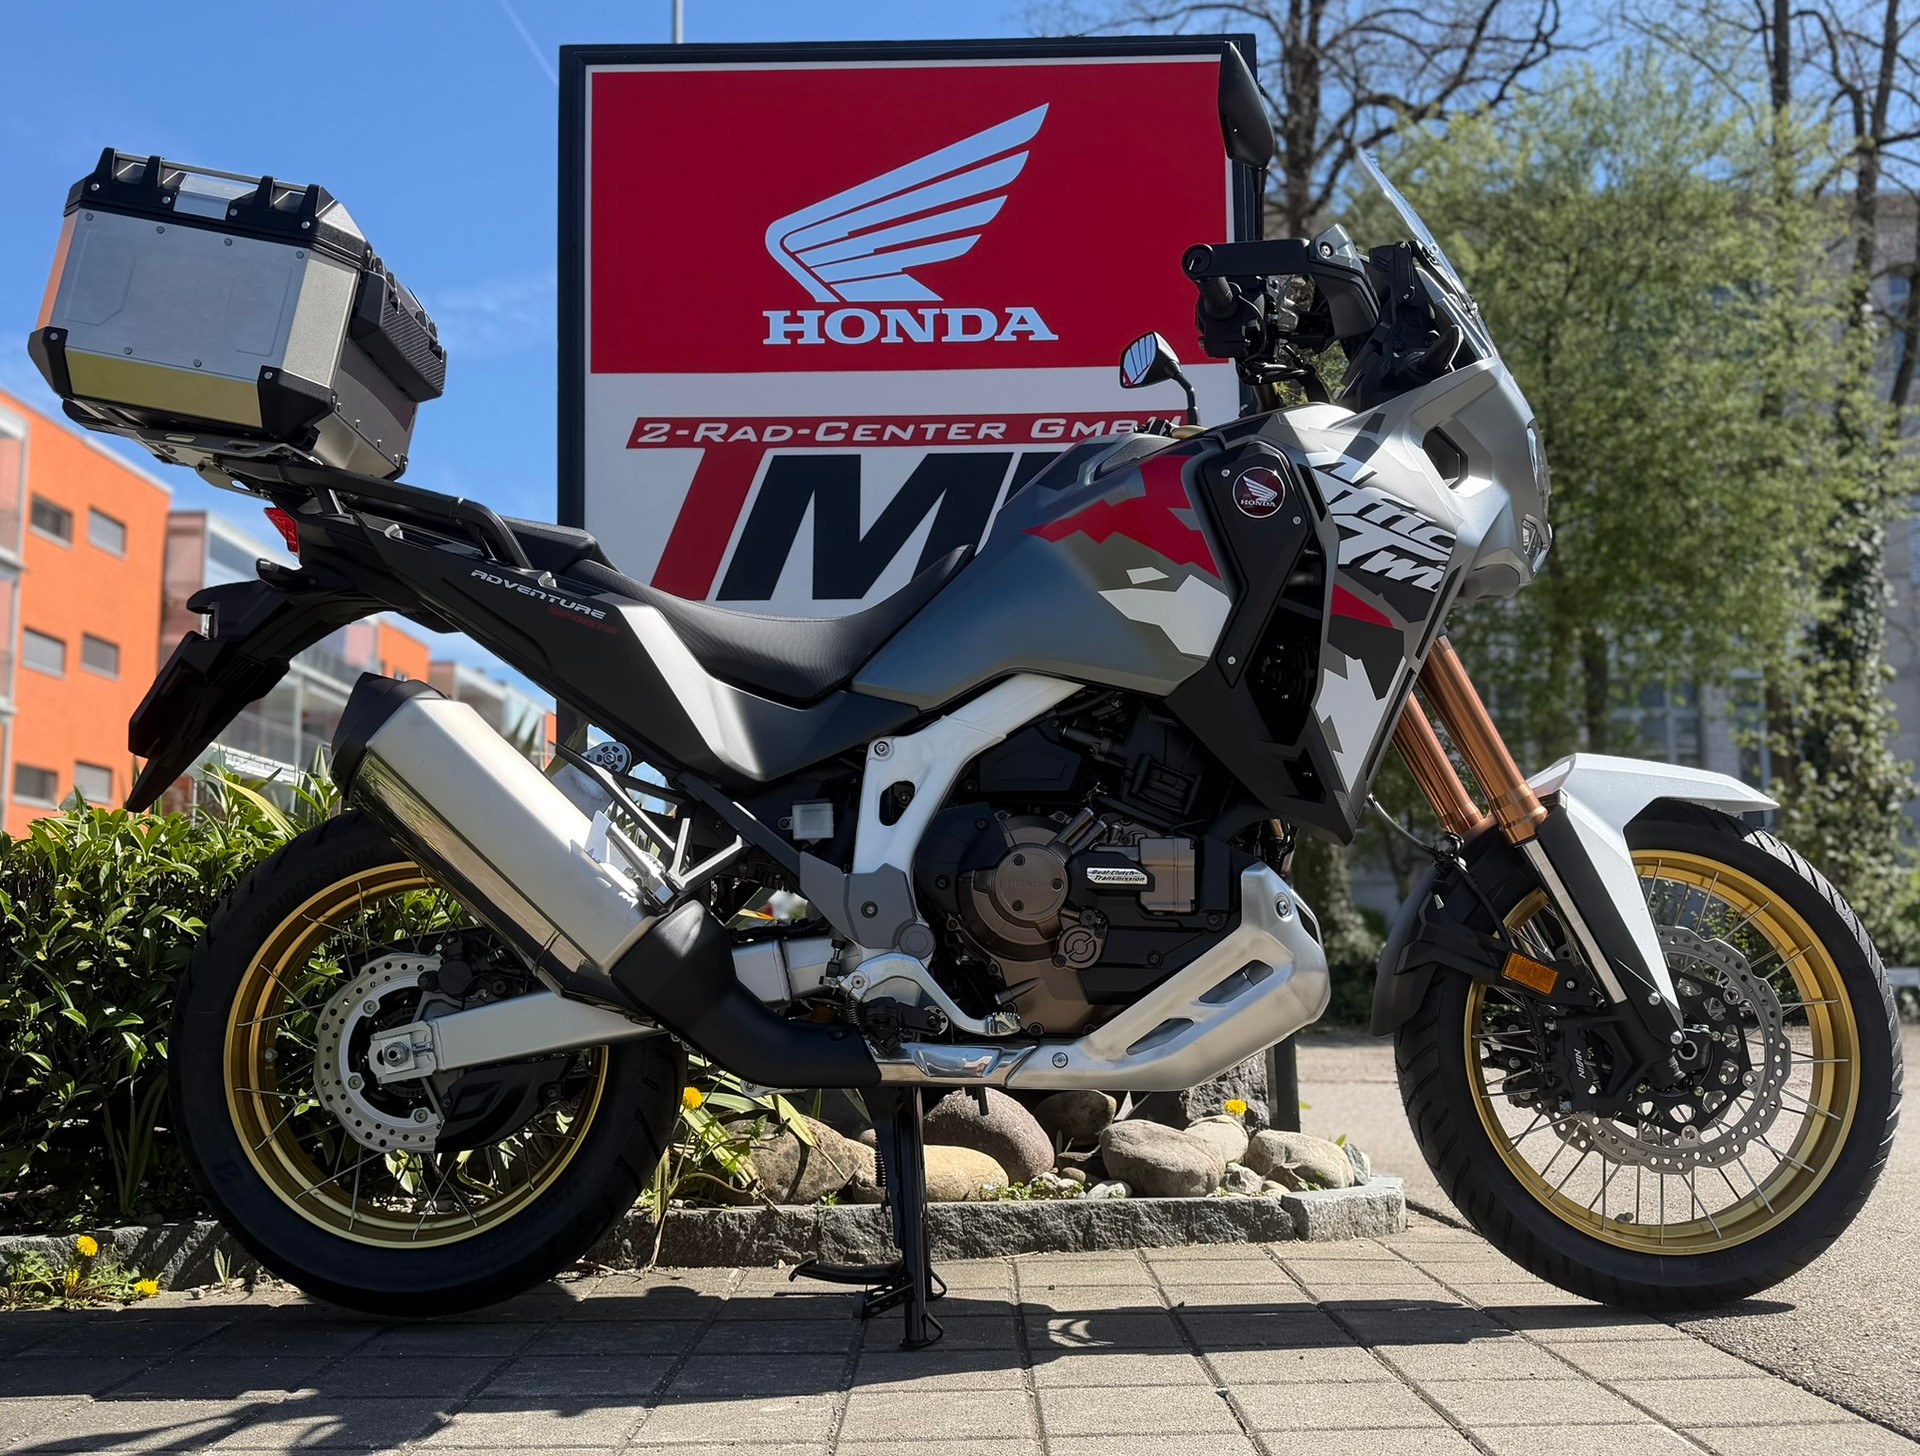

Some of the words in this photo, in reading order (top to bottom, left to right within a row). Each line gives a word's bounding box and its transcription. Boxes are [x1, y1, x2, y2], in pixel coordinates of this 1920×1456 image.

[762, 306, 1059, 346] HONDA
[1240, 499, 1277, 508] HONDA
[470, 569, 607, 620] ADVENTURE
